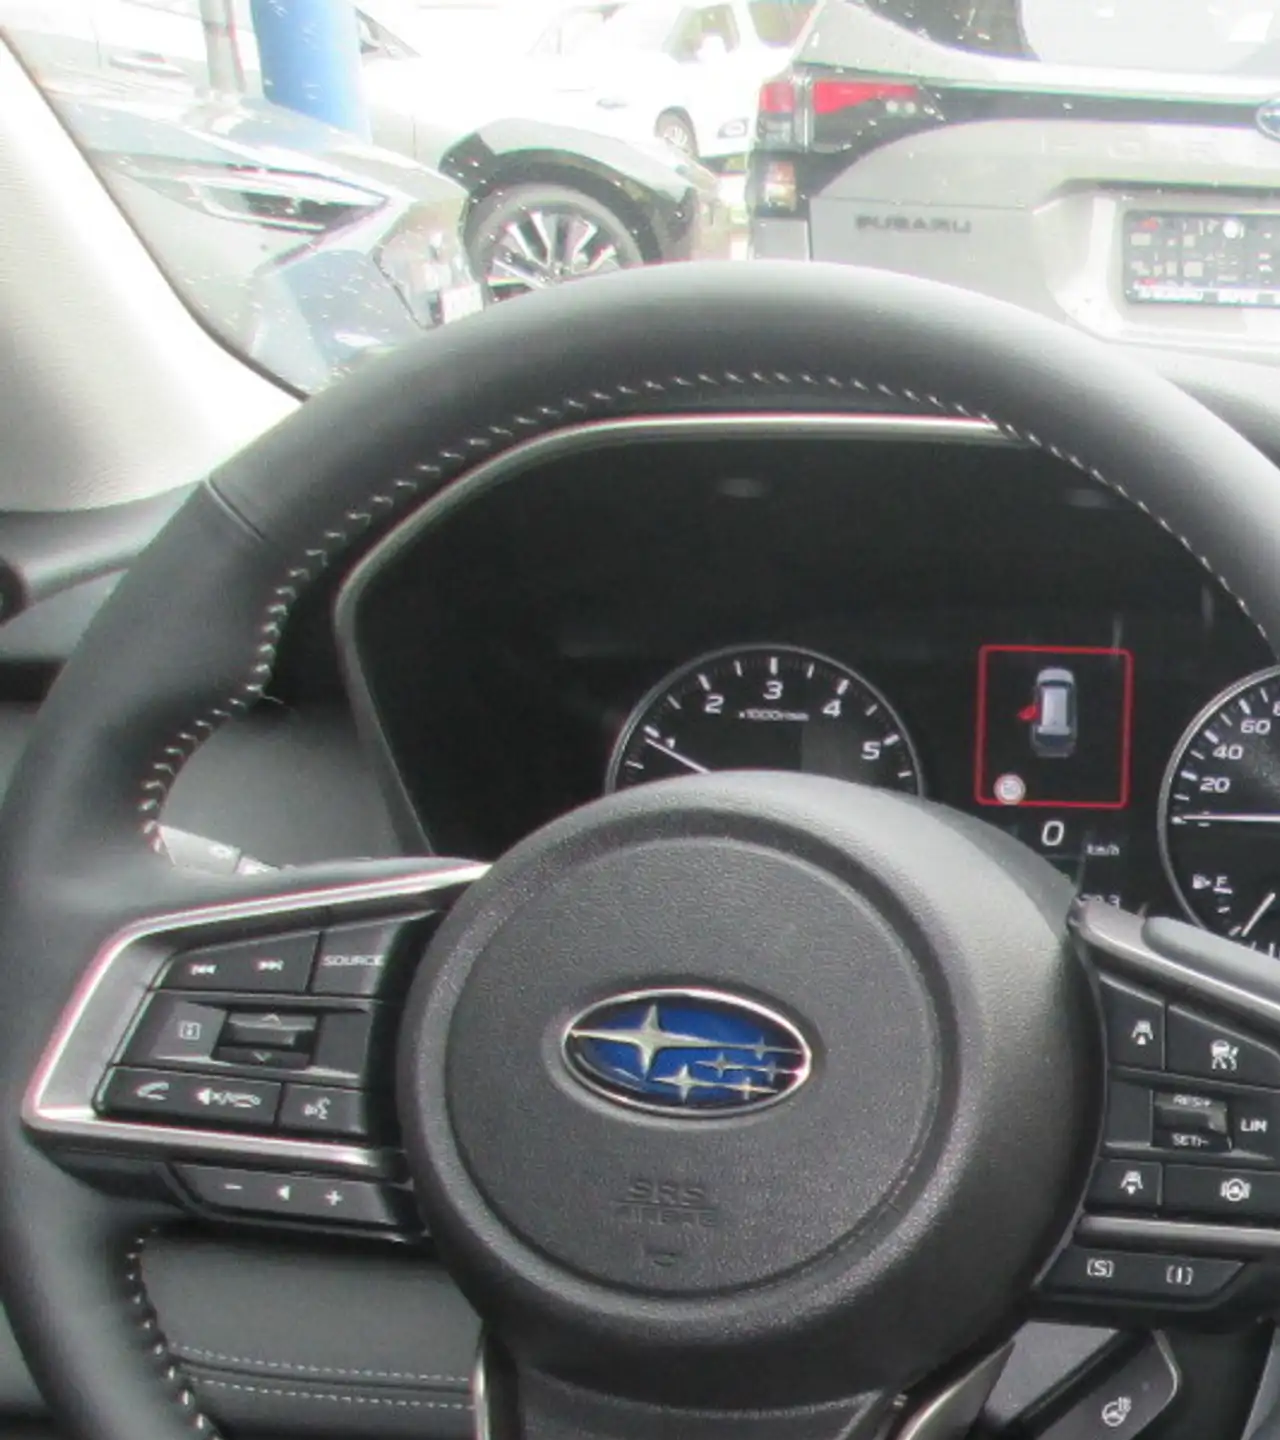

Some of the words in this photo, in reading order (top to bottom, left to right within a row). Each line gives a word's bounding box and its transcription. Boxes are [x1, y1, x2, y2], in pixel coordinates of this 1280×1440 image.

[763, 681, 783, 699] 3
[704, 695, 725, 713] 2
[822, 700, 841, 717] 4
[1240, 719, 1272, 735] 60
[861, 741, 882, 760] 5
[1212, 744, 1244, 760] 40
[1199, 776, 1231, 793] 20
[1041, 820, 1065, 846] 0
[1216, 875, 1228, 888] F
[322, 954, 385, 967] SOURCE
[1240, 1118, 1267, 1133] LIM
